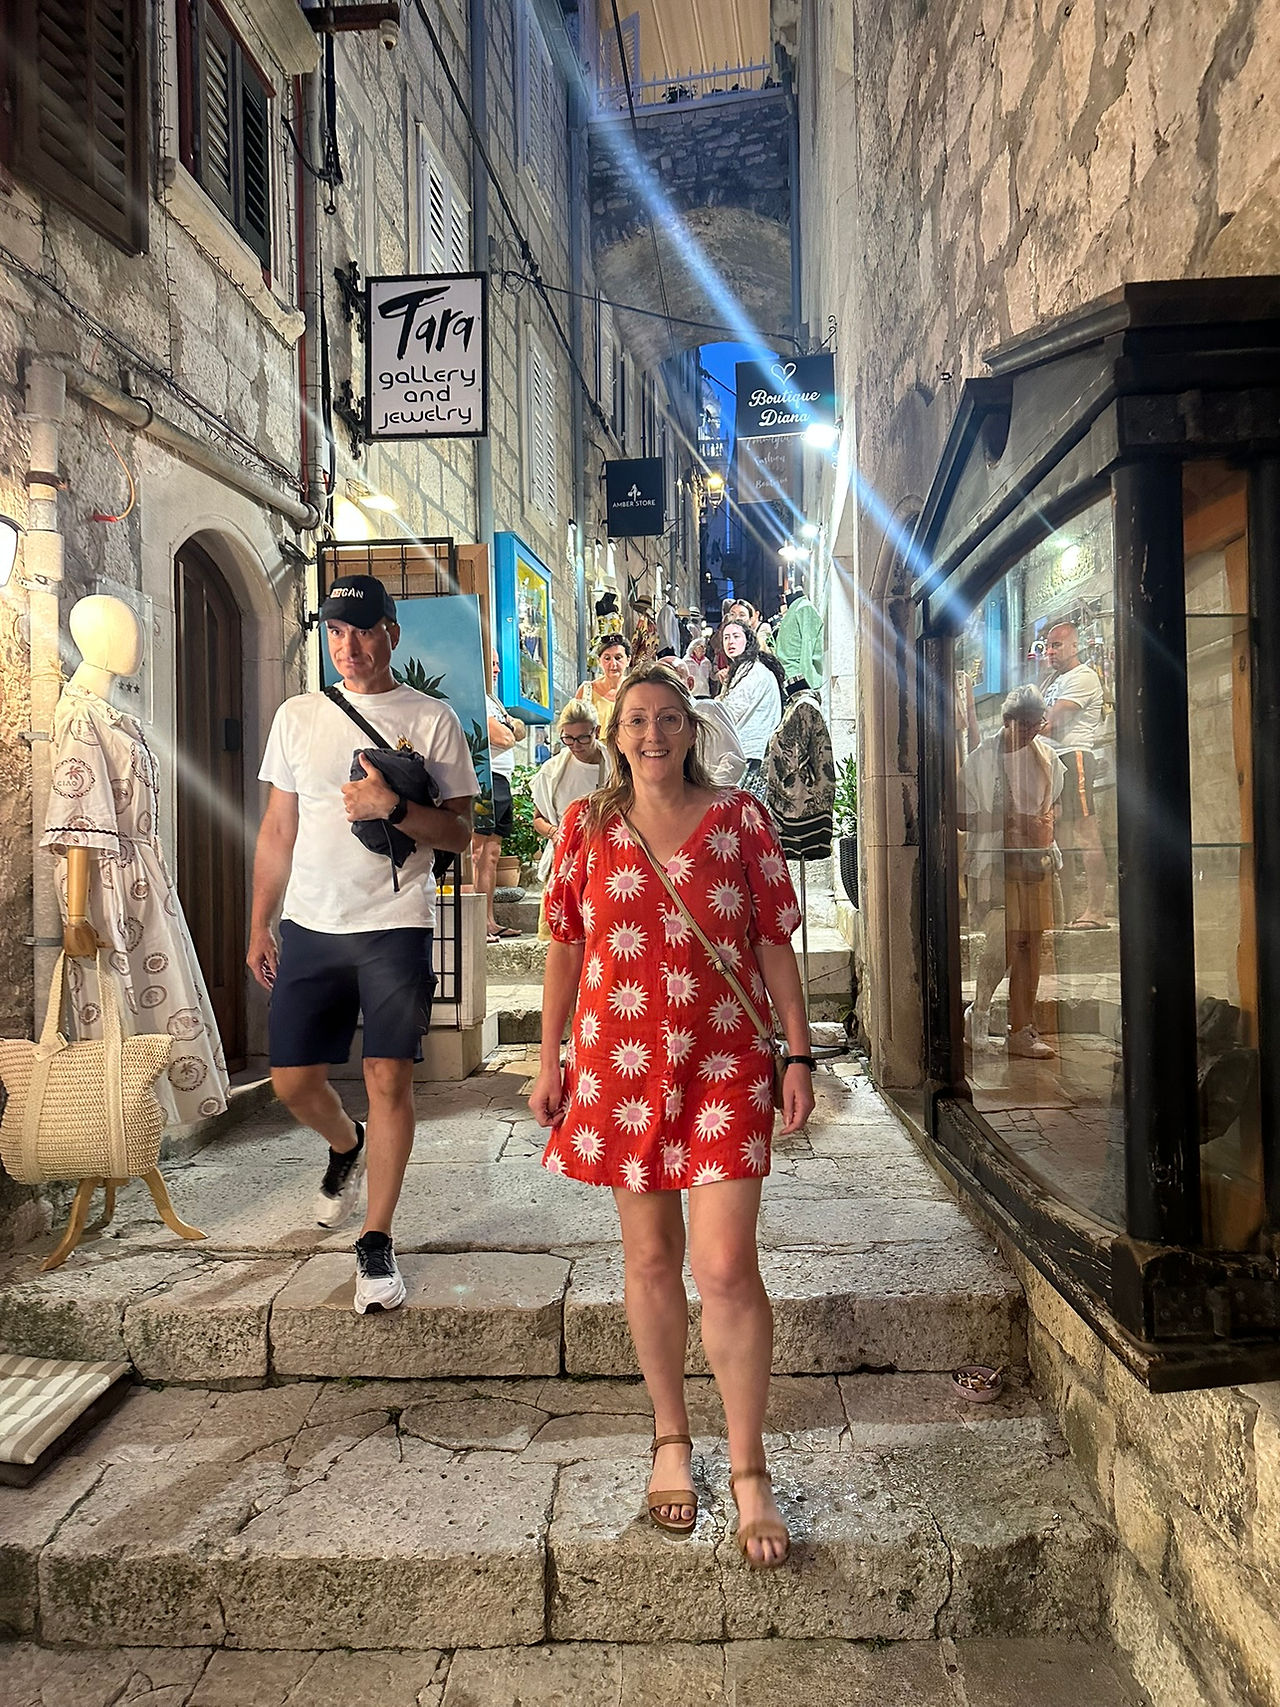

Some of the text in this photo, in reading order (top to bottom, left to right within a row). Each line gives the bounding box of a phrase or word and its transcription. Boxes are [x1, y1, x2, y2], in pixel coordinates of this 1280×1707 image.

[378, 286, 474, 360] Tara
[379, 365, 476, 390] gallery
[404, 385, 451, 403] and
[748, 389, 821, 408] Boutique
[758, 409, 811, 427] Diana
[635, 499, 656, 507] STORE
